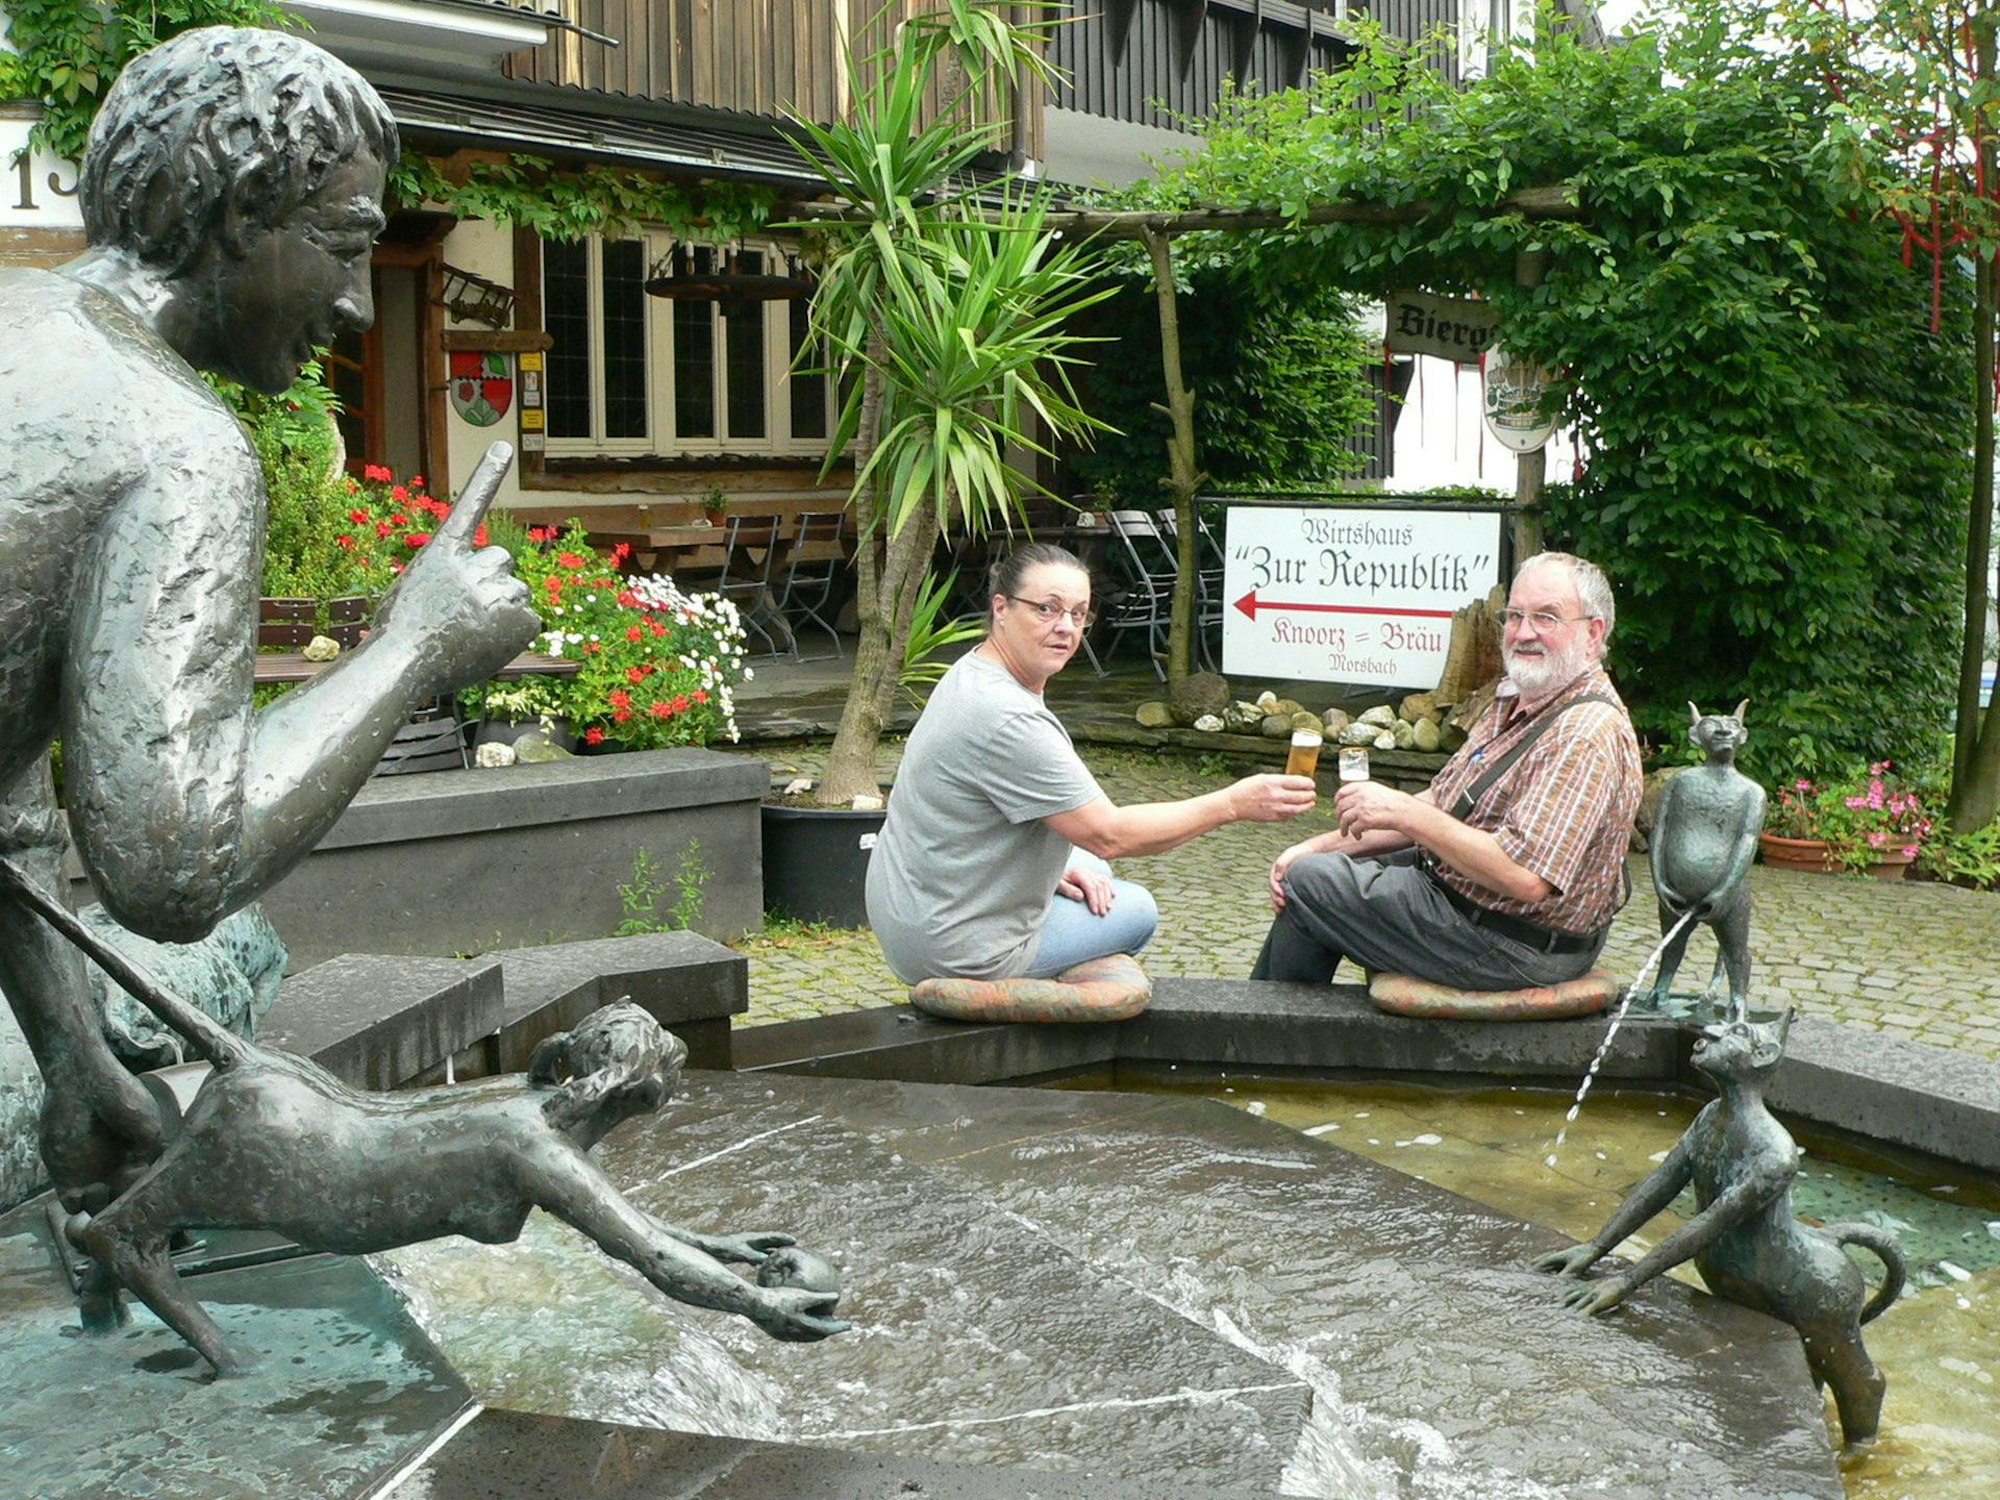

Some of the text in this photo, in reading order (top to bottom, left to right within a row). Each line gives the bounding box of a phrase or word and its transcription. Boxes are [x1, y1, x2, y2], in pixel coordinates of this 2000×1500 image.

[1302, 518, 1413, 550] Wirtshaus
[1235, 546, 1490, 596] "Zur Republik"
[1271, 617, 1346, 652] Knoorz
[1380, 621, 1443, 652] Bräu
[1328, 653, 1397, 676] Morsbach
